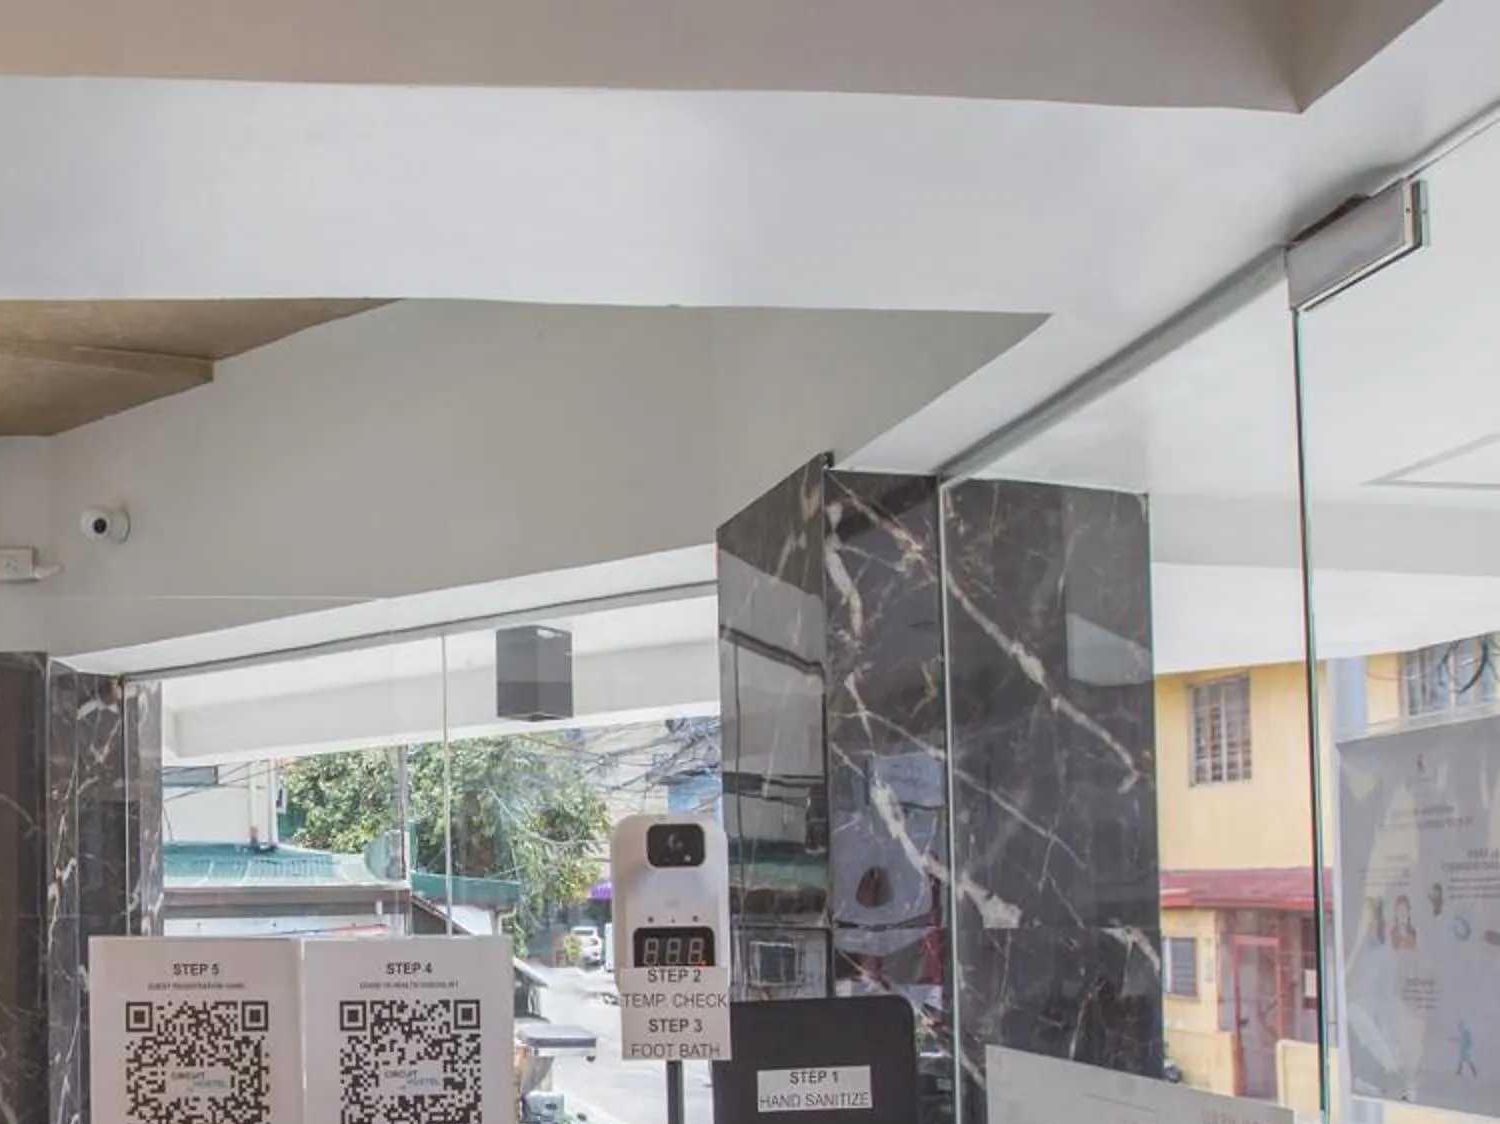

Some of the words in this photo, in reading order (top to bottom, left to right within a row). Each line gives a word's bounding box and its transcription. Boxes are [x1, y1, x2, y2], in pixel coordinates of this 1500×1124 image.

[173, 963, 209, 976] STEP
[211, 963, 220, 976] 5
[387, 962, 421, 975] STEP
[424, 962, 433, 975] 4
[647, 968, 689, 983] STEP
[692, 968, 702, 982] 2
[672, 993, 727, 1008] CHECK
[648, 1018, 689, 1033] STEP
[694, 1018, 703, 1032] 3
[631, 1043, 676, 1058] FOOT
[680, 1043, 720, 1057] BATH
[789, 1071, 828, 1085] STEP
[832, 1070, 839, 1083] 1
[759, 1093, 801, 1109] HAND
[805, 1091, 870, 1107] SANITIZE
